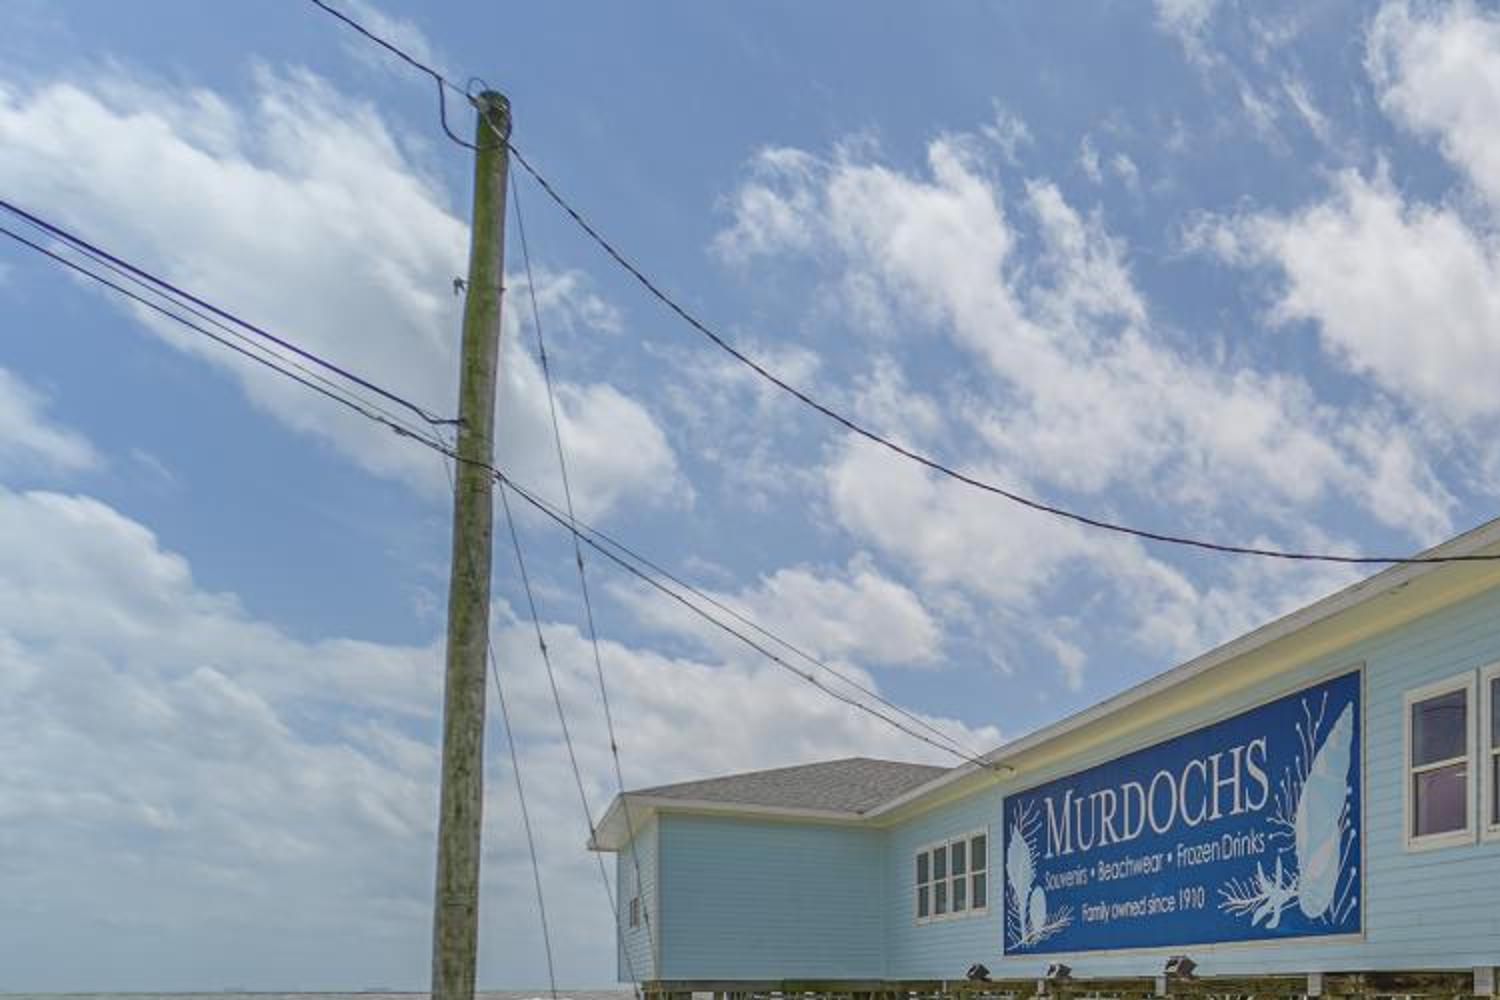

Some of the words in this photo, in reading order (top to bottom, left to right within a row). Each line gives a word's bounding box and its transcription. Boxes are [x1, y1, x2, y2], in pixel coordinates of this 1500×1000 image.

[1044, 735, 1269, 859] MURDOCHS
[1044, 866, 1089, 891] Souvenirs
[1098, 852, 1164, 882] Beachwear
[1177, 841, 1221, 868] Frozen
[1221, 829, 1265, 862] Drinks
[1081, 900, 1110, 923] Family
[1111, 896, 1146, 919] owned
[1147, 892, 1176, 914] since
[1178, 886, 1205, 911] 1910
